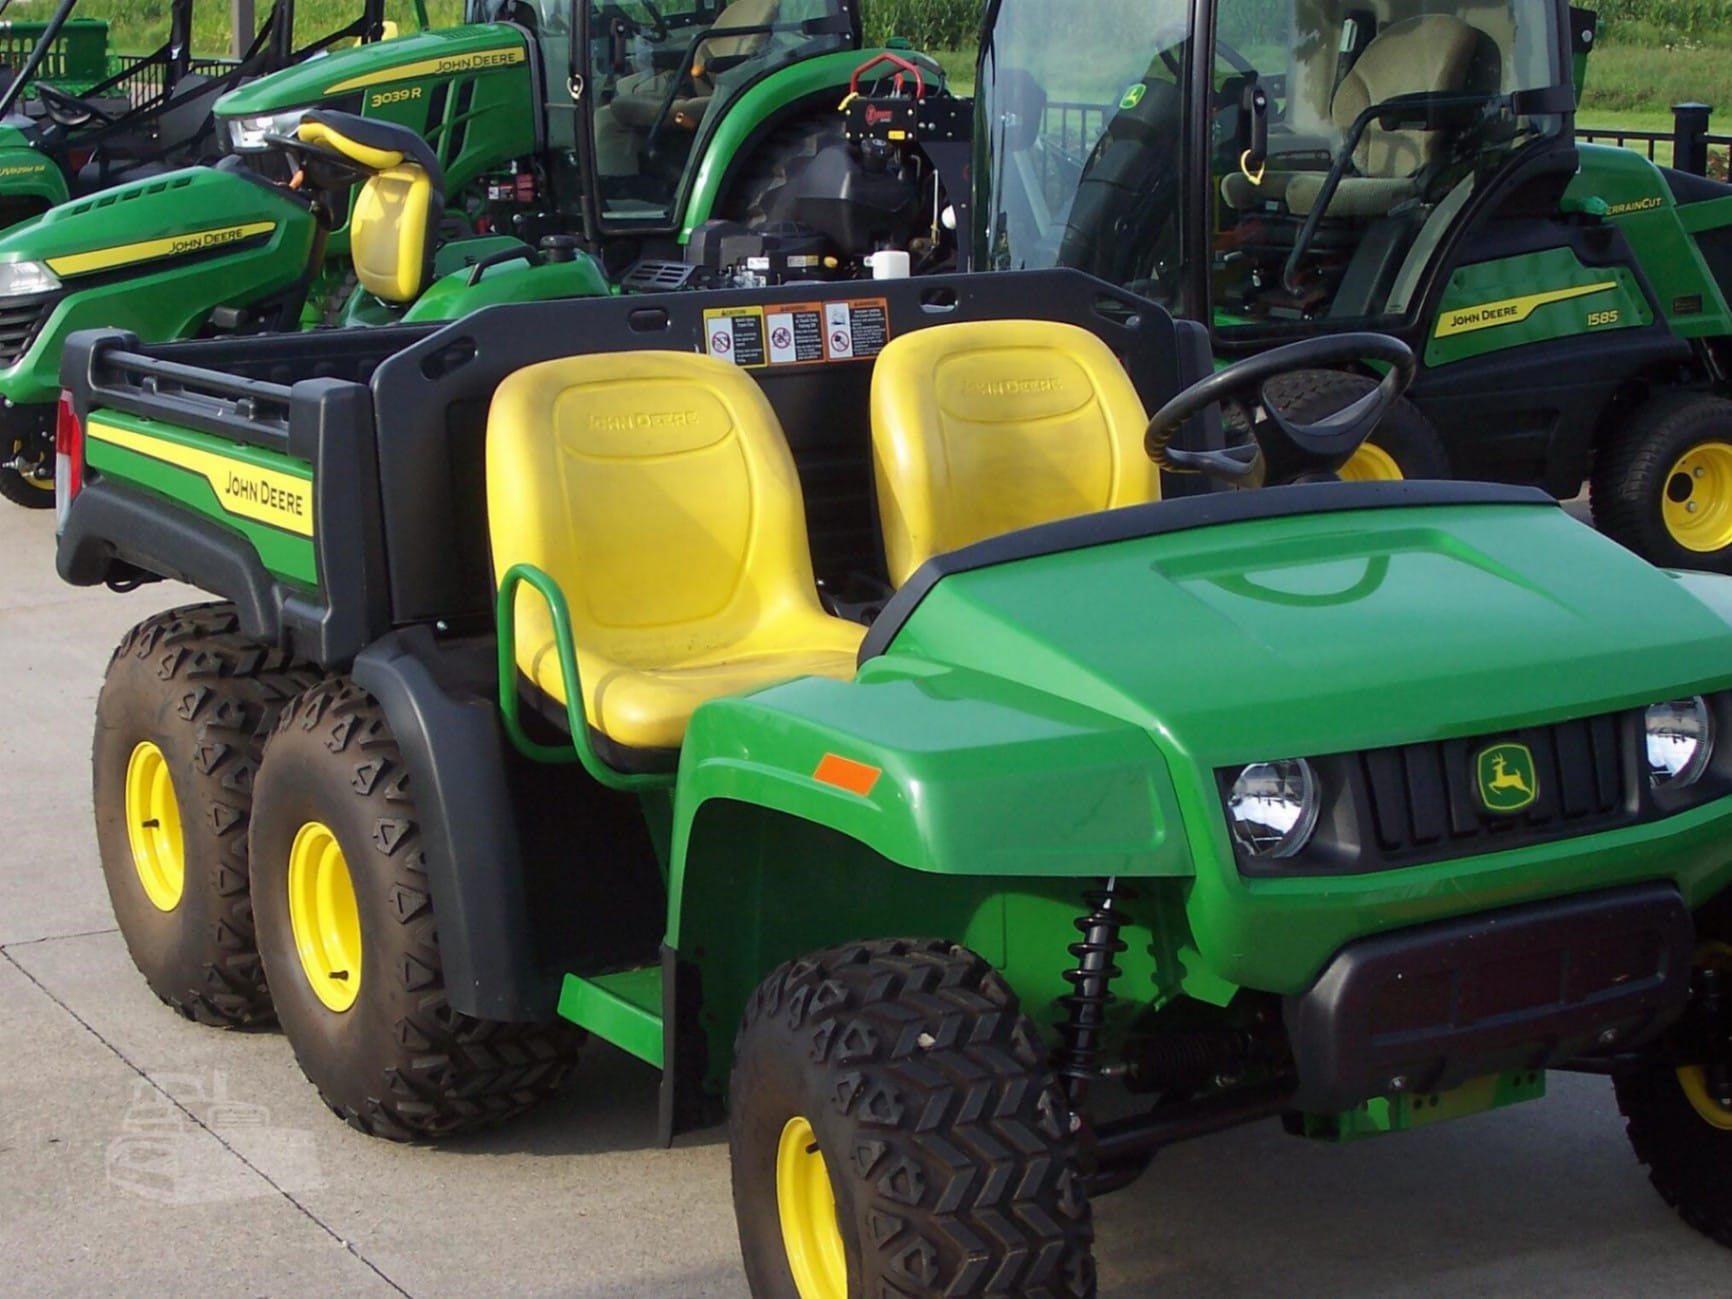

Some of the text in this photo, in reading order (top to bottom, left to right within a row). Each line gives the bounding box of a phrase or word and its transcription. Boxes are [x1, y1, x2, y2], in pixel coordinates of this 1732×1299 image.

[434, 52, 516, 72] JOHN DEERE
[370, 88, 410, 108] 3039
[1606, 197, 1662, 216] ERRAINCUT
[168, 228, 243, 254] JOHN DEERE
[1451, 305, 1518, 327] JOHN DEERE
[1587, 310, 1619, 326] 1585
[225, 471, 303, 516] JOHN DEERE
